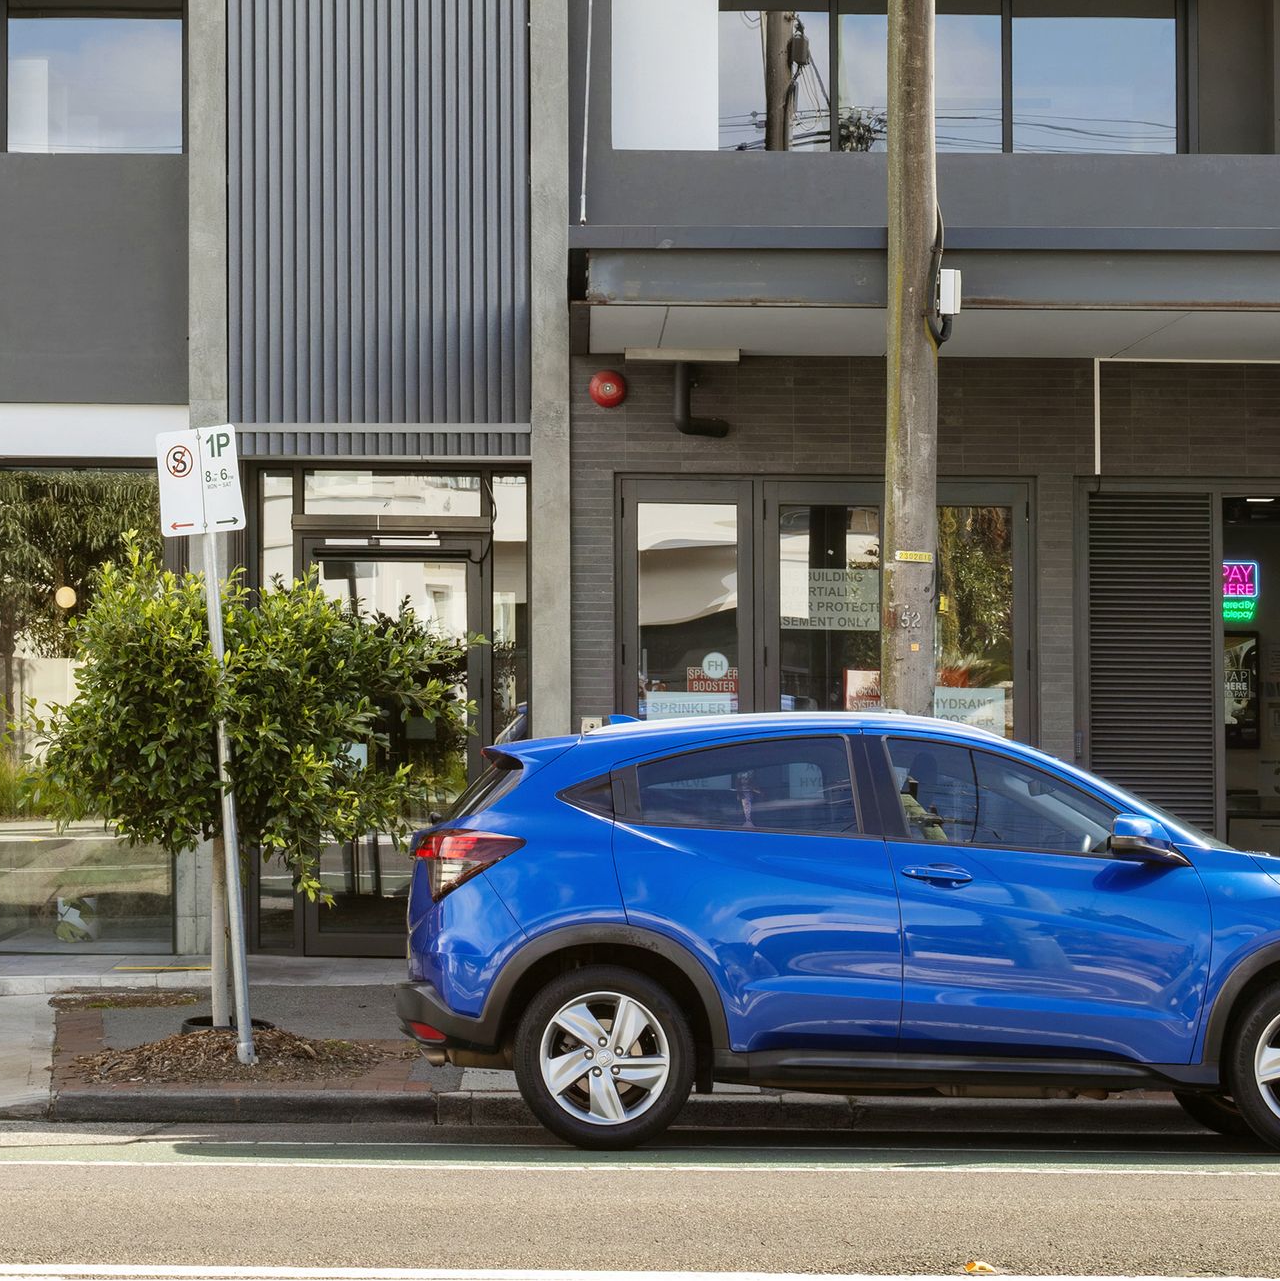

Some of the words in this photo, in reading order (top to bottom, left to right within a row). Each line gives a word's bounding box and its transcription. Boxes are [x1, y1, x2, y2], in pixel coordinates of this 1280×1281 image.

[206, 433, 230, 458] 1P
[901, 611, 920, 628] 52
[707, 660, 724, 672] FH
[1224, 671, 1248, 681] TAP
[693, 681, 736, 692] BOOSTER
[651, 702, 726, 714] SPRINKLER
